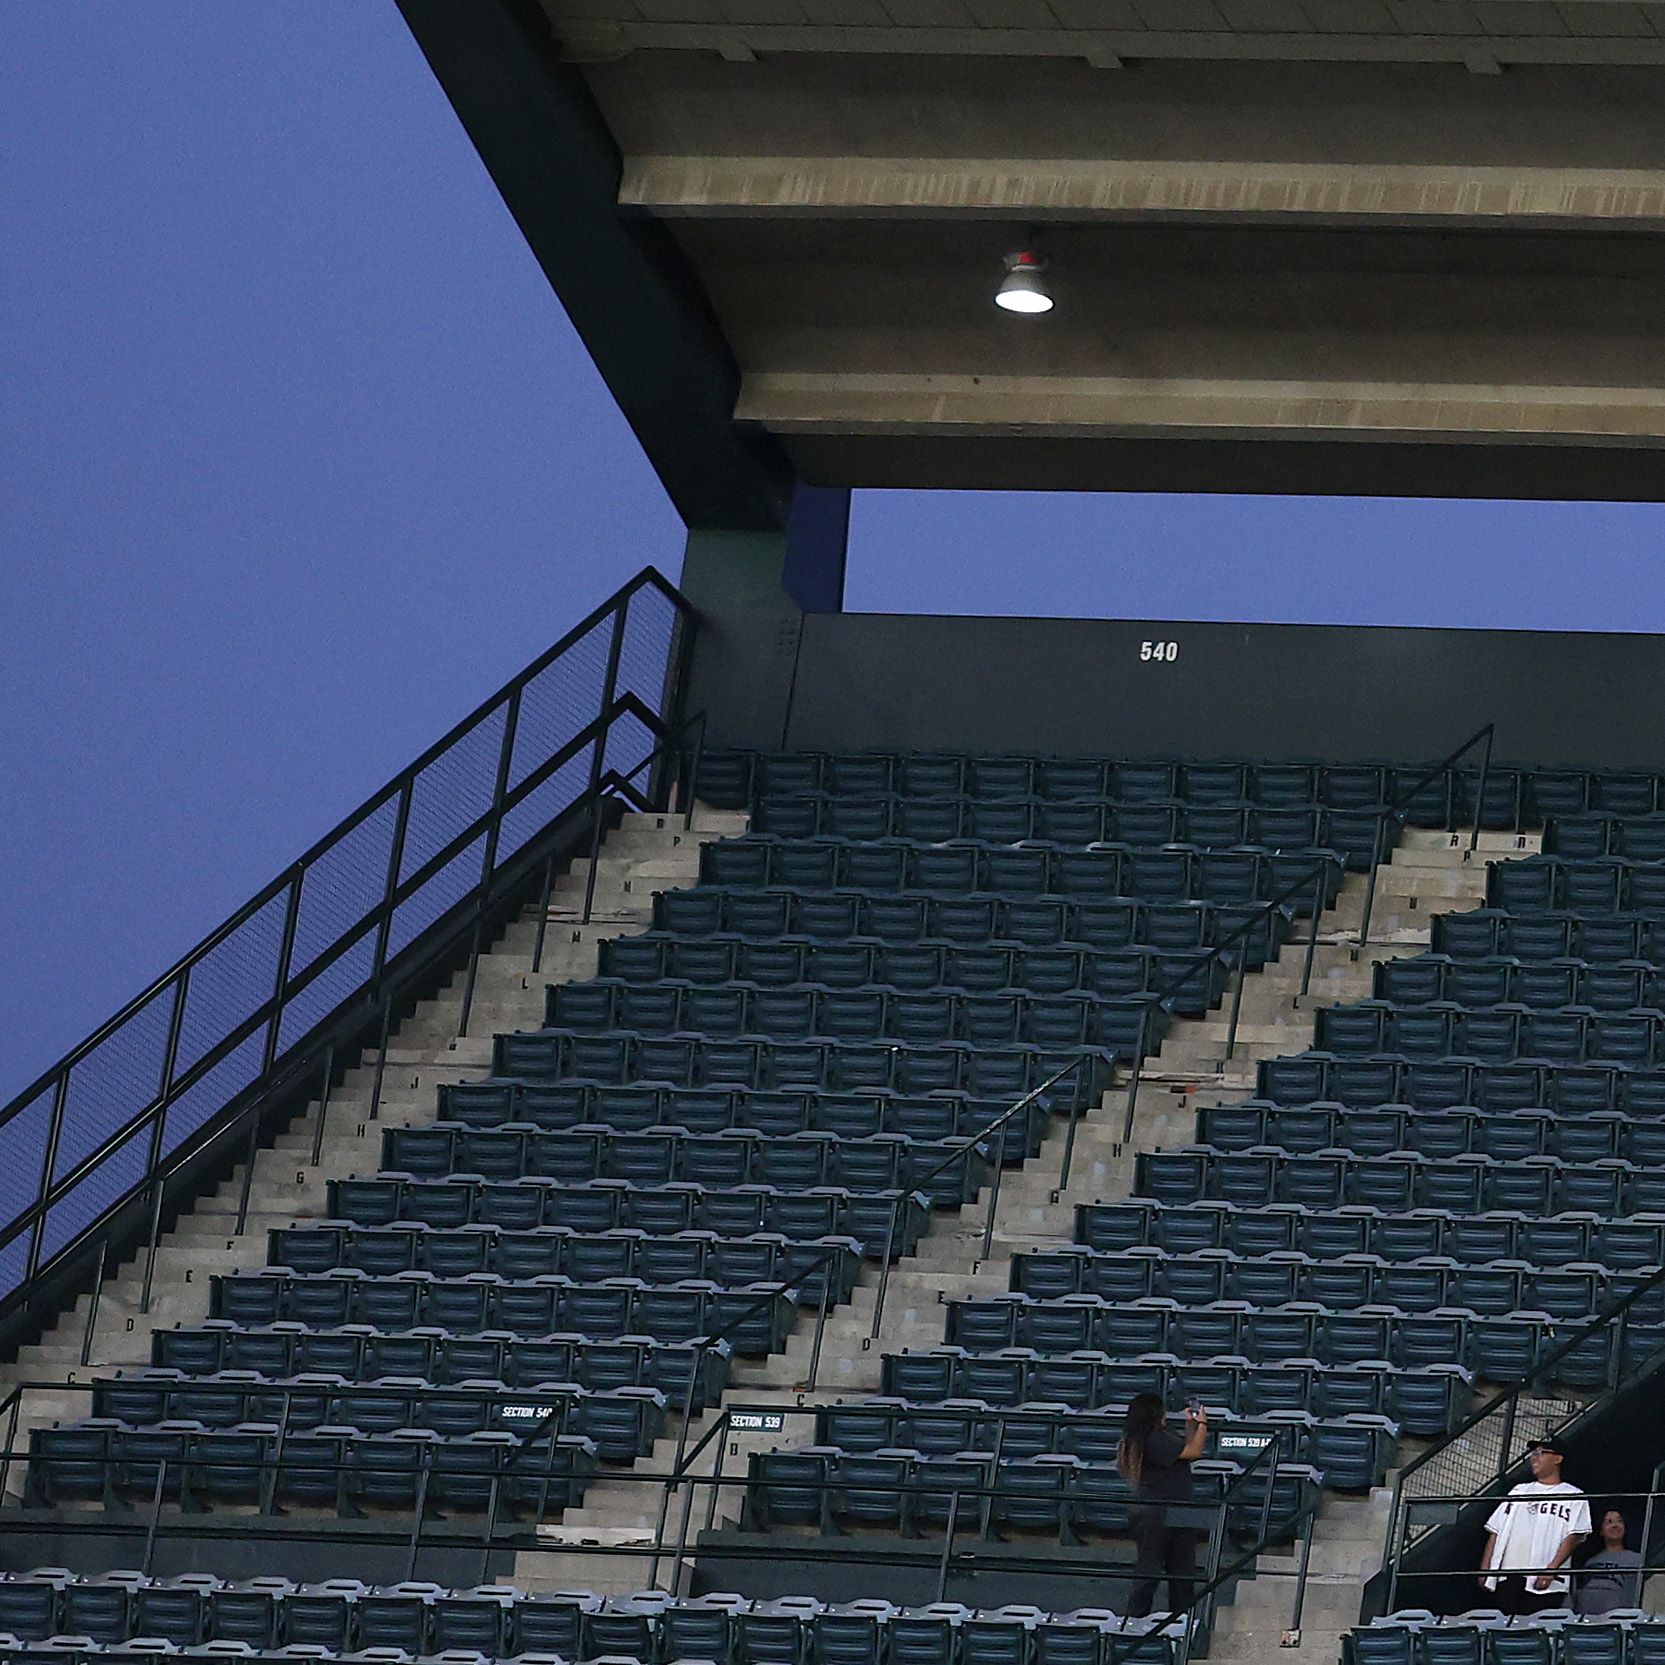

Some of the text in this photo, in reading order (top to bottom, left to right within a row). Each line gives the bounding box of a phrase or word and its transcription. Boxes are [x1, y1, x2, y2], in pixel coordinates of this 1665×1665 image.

[1140, 641, 1178, 662] 540
[522, 978, 528, 989] L
[1293, 997, 1300, 1009] L
[126, 1319, 134, 1331] D
[863, 1338, 871, 1351] D
[797, 1394, 805, 1406] C
[502, 1406, 535, 1418] SECTION
[730, 1415, 781, 1428] SECTION 539
[1221, 1437, 1248, 1447] SECTION
